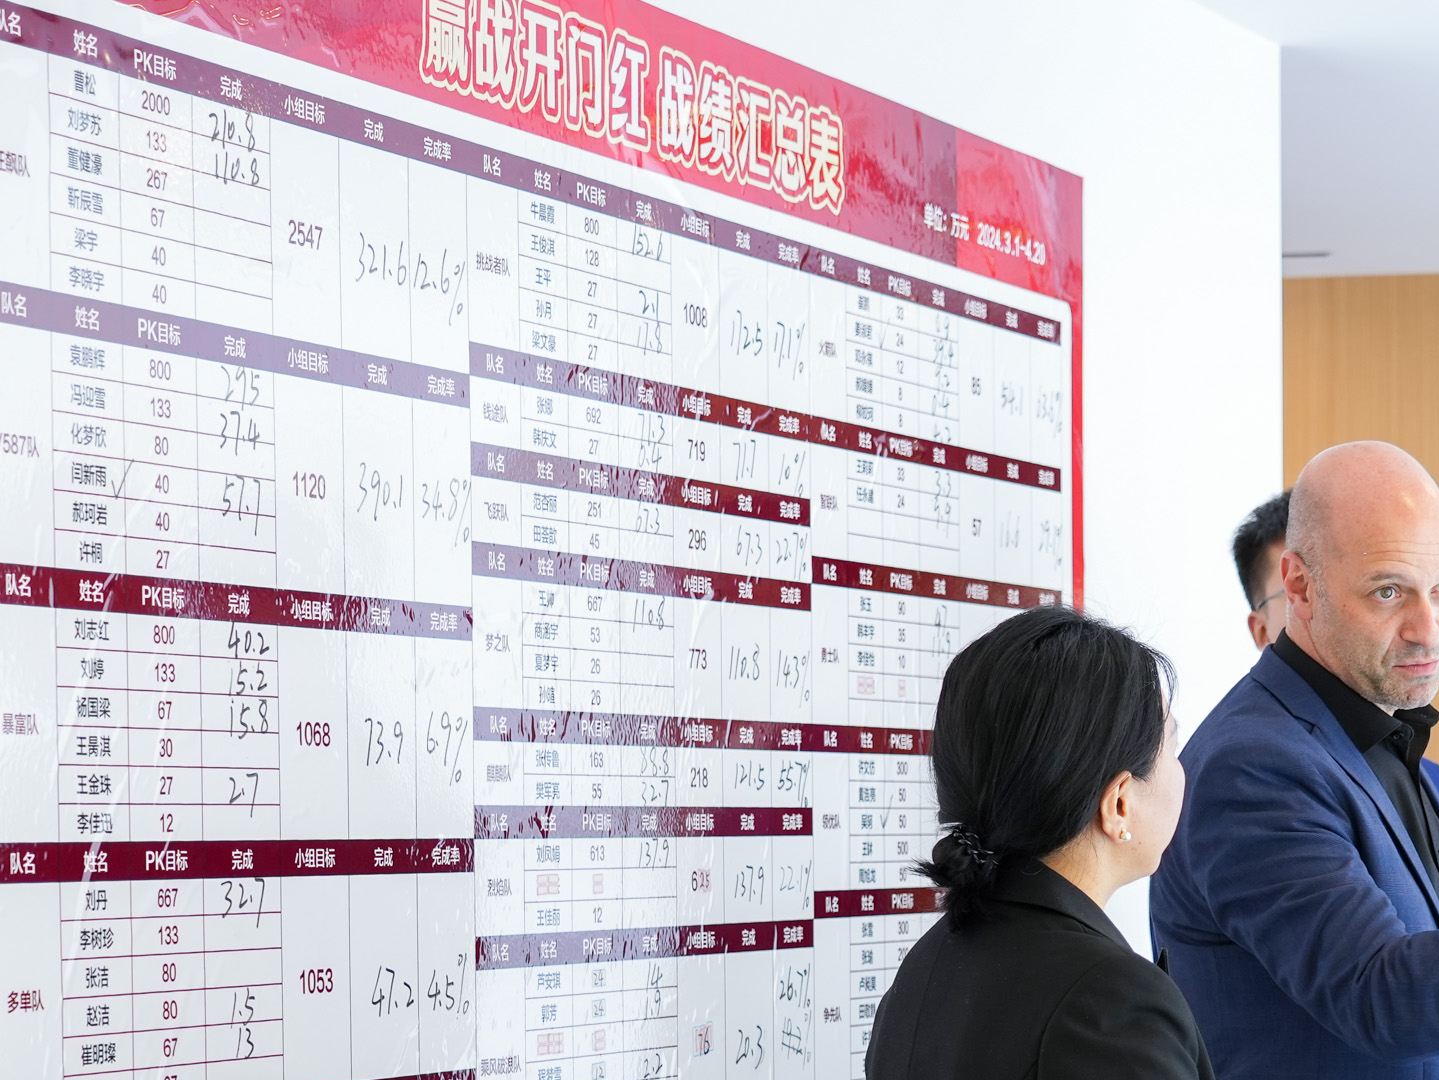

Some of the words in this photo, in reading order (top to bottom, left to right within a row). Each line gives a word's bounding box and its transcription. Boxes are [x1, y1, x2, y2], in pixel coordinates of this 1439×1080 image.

[73, 30, 98, 57] 姓名
[134, 49, 177, 81] PK目标
[220, 75, 242, 100] 完成
[141, 90, 170, 116] 2000
[284, 95, 325, 125] 小组目标
[423, 0, 649, 145] 赢战开门红
[658, 49, 843, 210] 战绩汇总表
[146, 130, 167, 152] 133
[363, 118, 384, 142] 完成
[423, 136, 452, 161] 完成率
[483, 154, 501, 176] 队名
[146, 168, 167, 191] 267
[534, 169, 551, 191] 姓名
[576, 182, 606, 207] PK目标
[150, 209, 165, 230] 67
[584, 218, 599, 235] 800
[681, 214, 710, 237] 小组目标
[74, 229, 98, 252] 梁宇
[288, 220, 323, 252] 2547
[152, 246, 166, 266] 40
[476, 251, 511, 276] 挑战者队
[585, 249, 599, 267] 128
[69, 265, 104, 292] 李晓宇
[535, 268, 551, 286] 王平
[2, 292, 27, 318] 队名
[152, 284, 167, 304] 40
[75, 305, 100, 331] 姓名
[536, 300, 552, 319] 孙月
[684, 303, 708, 328] 1008
[138, 317, 181, 346] PK目标
[224, 334, 246, 359] 完成
[150, 359, 171, 381] 800
[287, 347, 329, 374] 小组目标
[367, 364, 388, 385] 完成
[427, 374, 455, 398] 完成率
[150, 398, 171, 418] 133
[483, 402, 508, 424] 钱途队
[586, 408, 601, 424] 692
[0, 433, 40, 458] 587队
[70, 422, 106, 449] 化梦欣
[155, 436, 169, 457] 80
[533, 429, 557, 448] 韩庆文
[688, 439, 706, 462] 719
[155, 473, 170, 494] 40
[292, 471, 326, 500] 1120
[72, 501, 107, 526] 郝珂岩
[155, 511, 170, 532] 40
[483, 502, 509, 522] 飞跃队
[688, 530, 707, 551] 296
[156, 549, 170, 570] 27
[823, 564, 837, 581] 队名
[5, 573, 31, 598] 队名
[79, 580, 104, 604] 姓名
[141, 585, 184, 609] PK目标
[227, 593, 250, 616] 完成
[291, 599, 333, 622] 小组目标
[370, 607, 391, 627] 完成
[430, 611, 458, 631] 完成率
[74, 618, 109, 641] 刘志红
[154, 625, 175, 645] 800
[590, 628, 601, 642] 53
[485, 634, 510, 652] 梦之队
[81, 658, 104, 680] 刘婷
[689, 649, 707, 670] 773
[154, 662, 176, 682] 133
[76, 697, 111, 720] 杨国梁
[157, 701, 172, 720] 67
[2, 712, 39, 736] 暴富队
[296, 722, 331, 748] 1068
[159, 738, 173, 758] 30
[589, 752, 604, 768] 163
[897, 762, 908, 775] 300
[76, 773, 112, 796] 王金珠
[159, 776, 173, 795] 27
[690, 768, 709, 788] 218
[161, 813, 174, 833] 12
[686, 814, 714, 830] 小组目标
[782, 814, 803, 830] 完成率
[231, 849, 254, 870] 完成
[295, 848, 336, 867] 小组目标
[374, 847, 394, 866] 完成
[431, 846, 460, 866] 完成率
[590, 844, 605, 861] 613
[898, 842, 908, 855] 500
[10, 850, 36, 874] 队名
[84, 850, 108, 873] 姓名
[145, 850, 188, 872] PK目标
[488, 878, 512, 895] 烈焰队
[85, 890, 108, 911] 刘丹
[158, 888, 179, 908] 667
[825, 897, 839, 912] 队名
[537, 909, 561, 926] 王佳丽
[80, 927, 114, 950] 李树珍
[158, 925, 179, 946] 133
[85, 966, 109, 989] 张洁
[162, 962, 177, 983] 80
[299, 968, 334, 995] 1053
[7, 990, 44, 1014] 多单队
[163, 1000, 178, 1020] 80
[86, 1005, 110, 1027] 赵洁
[163, 1037, 178, 1058] 67
[481, 1056, 522, 1077] 乘风破浪队
